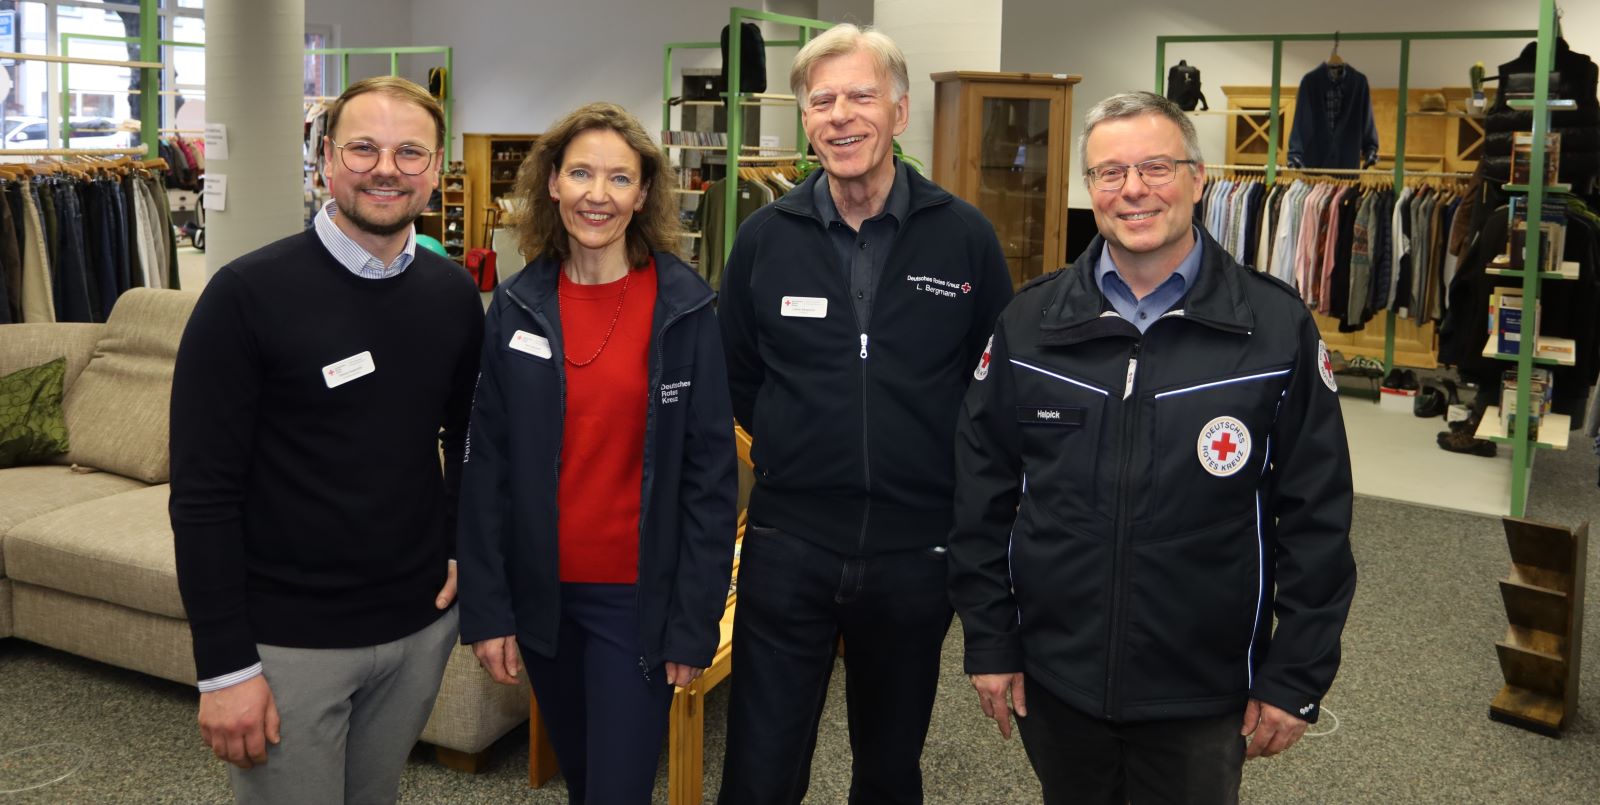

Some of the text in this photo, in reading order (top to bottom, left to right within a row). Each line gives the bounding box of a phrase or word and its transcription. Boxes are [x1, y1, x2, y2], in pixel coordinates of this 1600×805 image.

[925, 284, 957, 298] Bergmann
[661, 381, 691, 390] Deutsches
[1205, 421, 1245, 444] DEUTSCHES
[1202, 445, 1244, 471] ROTES KREUZ
